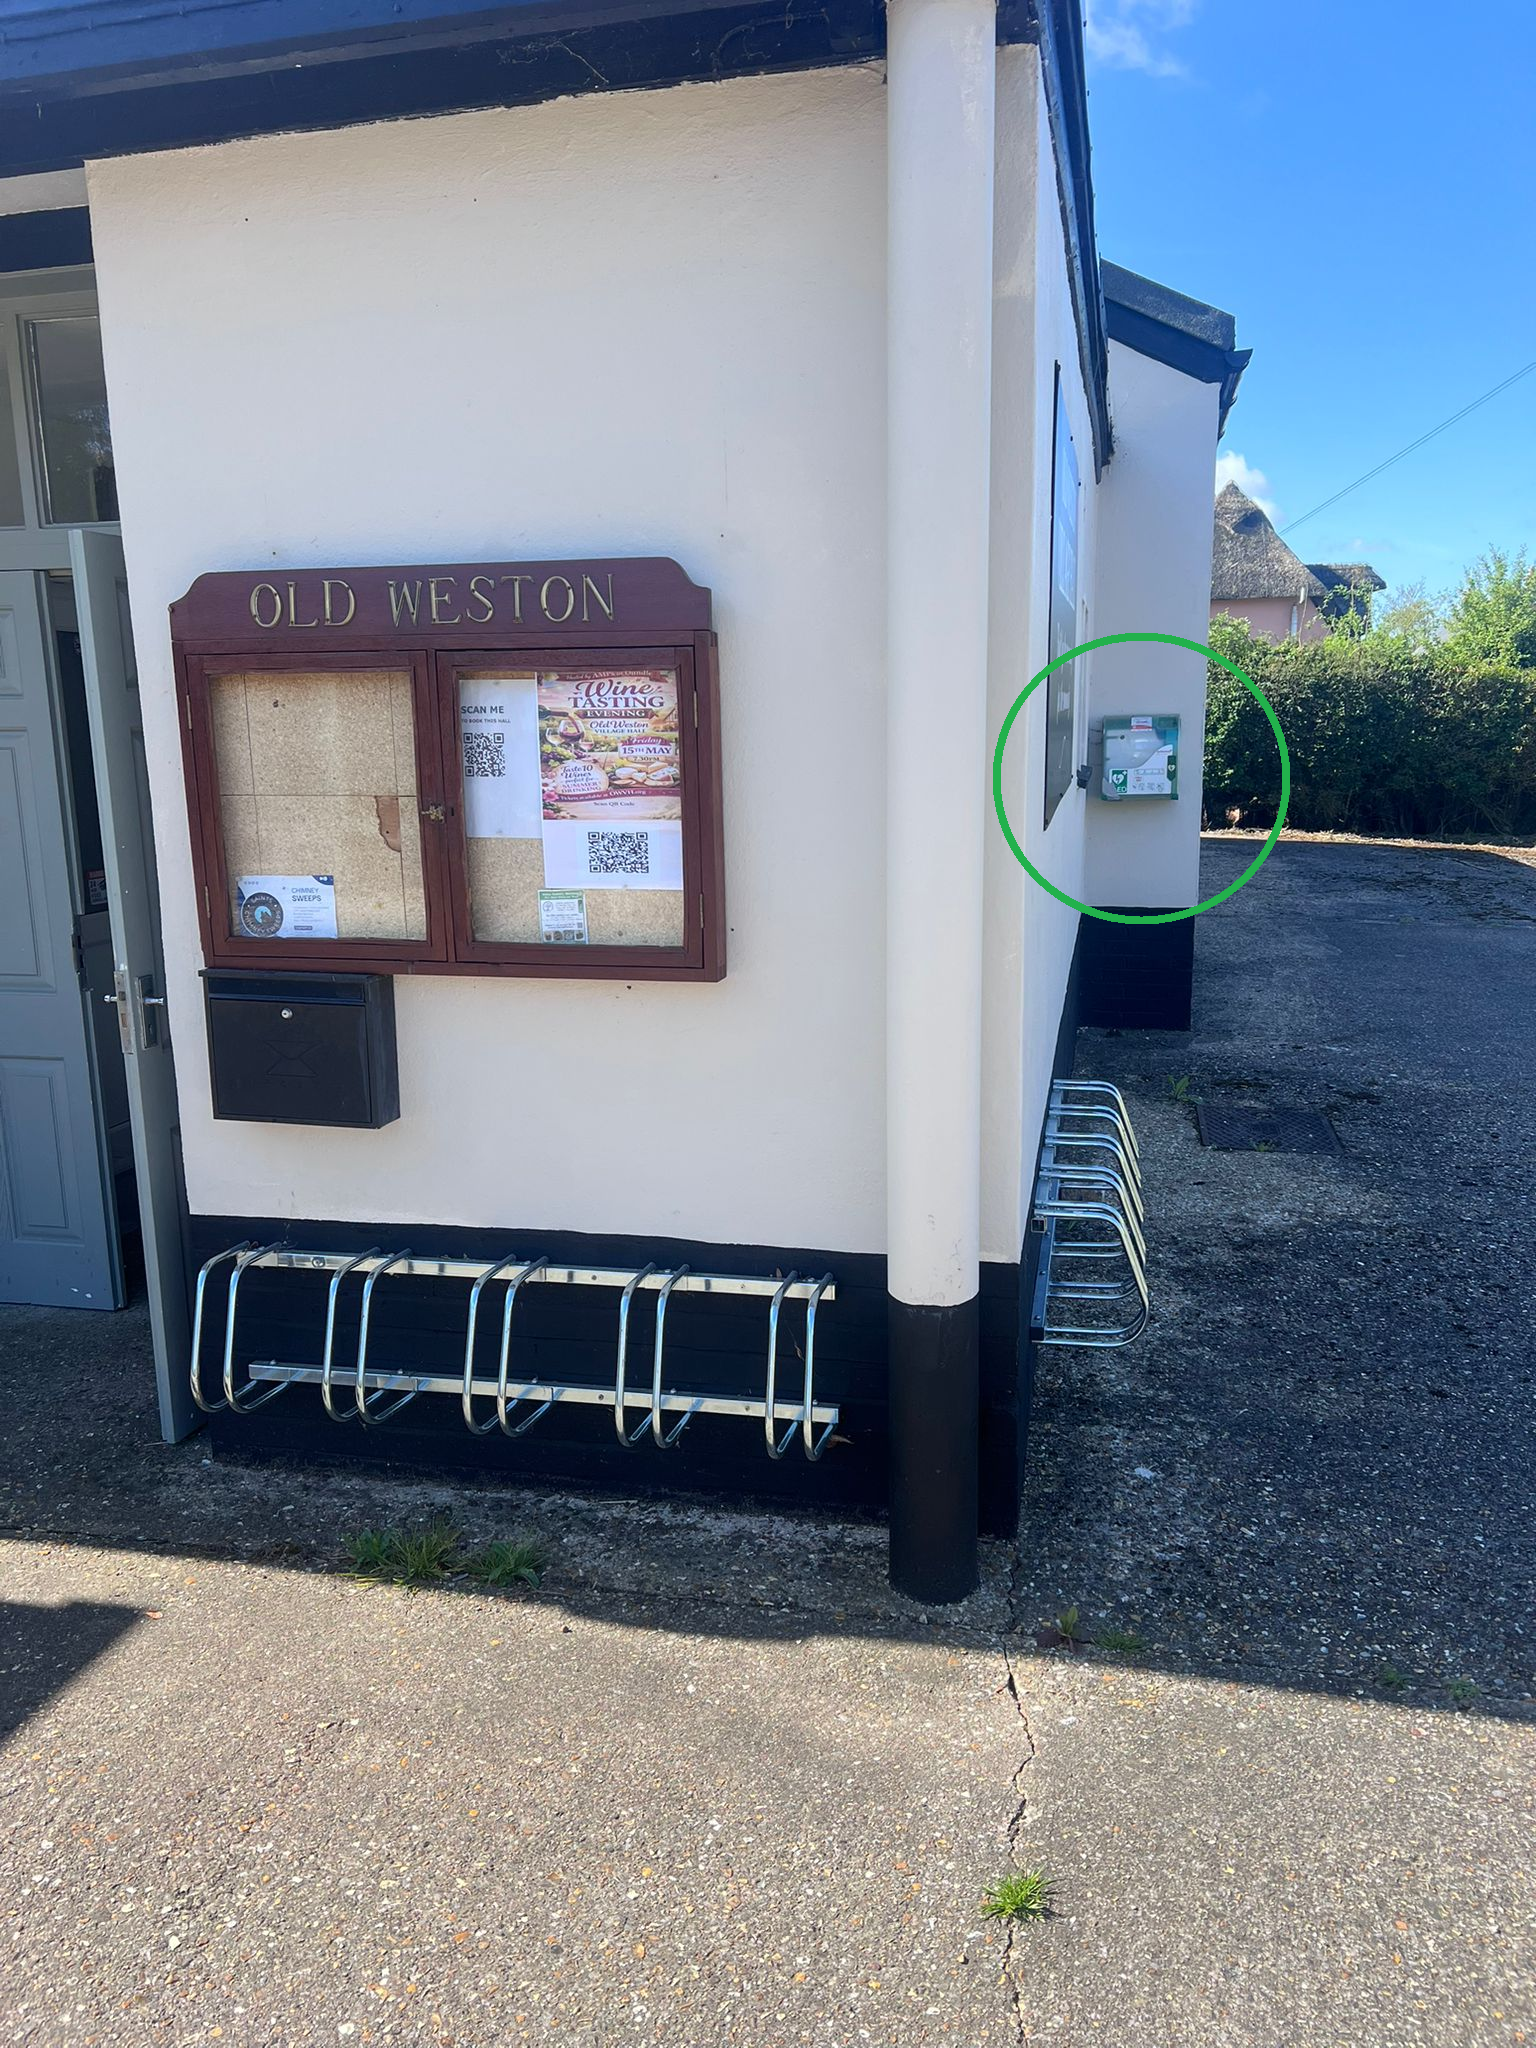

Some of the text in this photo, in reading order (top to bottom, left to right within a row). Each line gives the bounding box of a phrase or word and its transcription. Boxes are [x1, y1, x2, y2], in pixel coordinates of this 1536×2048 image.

[250, 573, 615, 628] OLD WESTON
[575, 679, 655, 698] Wine
[568, 696, 664, 709] TASTING
[460, 705, 504, 714] SCAN ME
[586, 709, 646, 717] EVENING
[589, 720, 649, 729] Old Weston
[631, 736, 662, 745] Friday
[645, 746, 672, 754] MAY
[561, 765, 582, 773] Taste
